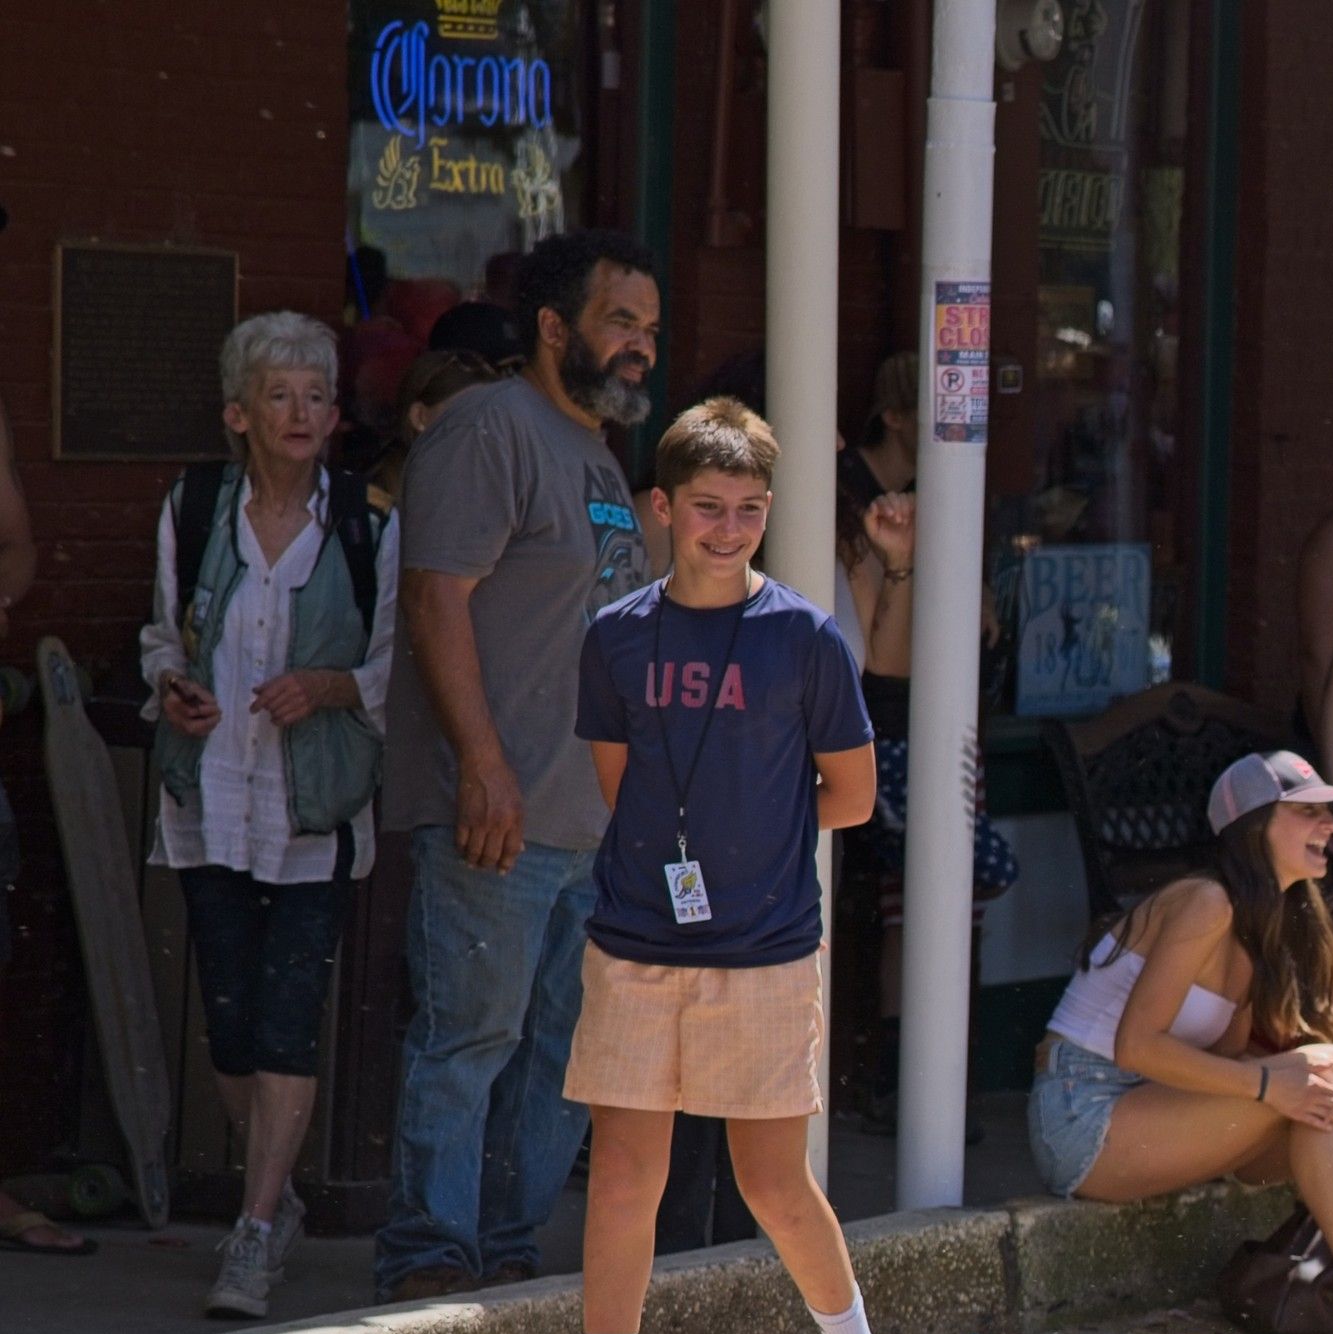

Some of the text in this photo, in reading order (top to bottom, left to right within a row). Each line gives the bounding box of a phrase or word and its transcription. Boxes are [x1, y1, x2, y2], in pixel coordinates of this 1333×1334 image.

[370, 19, 551, 149] Corona
[429, 137, 506, 194] Extra
[588, 502, 635, 531] GOES
[1029, 555, 1148, 622] BEER
[645, 661, 746, 711] USA
